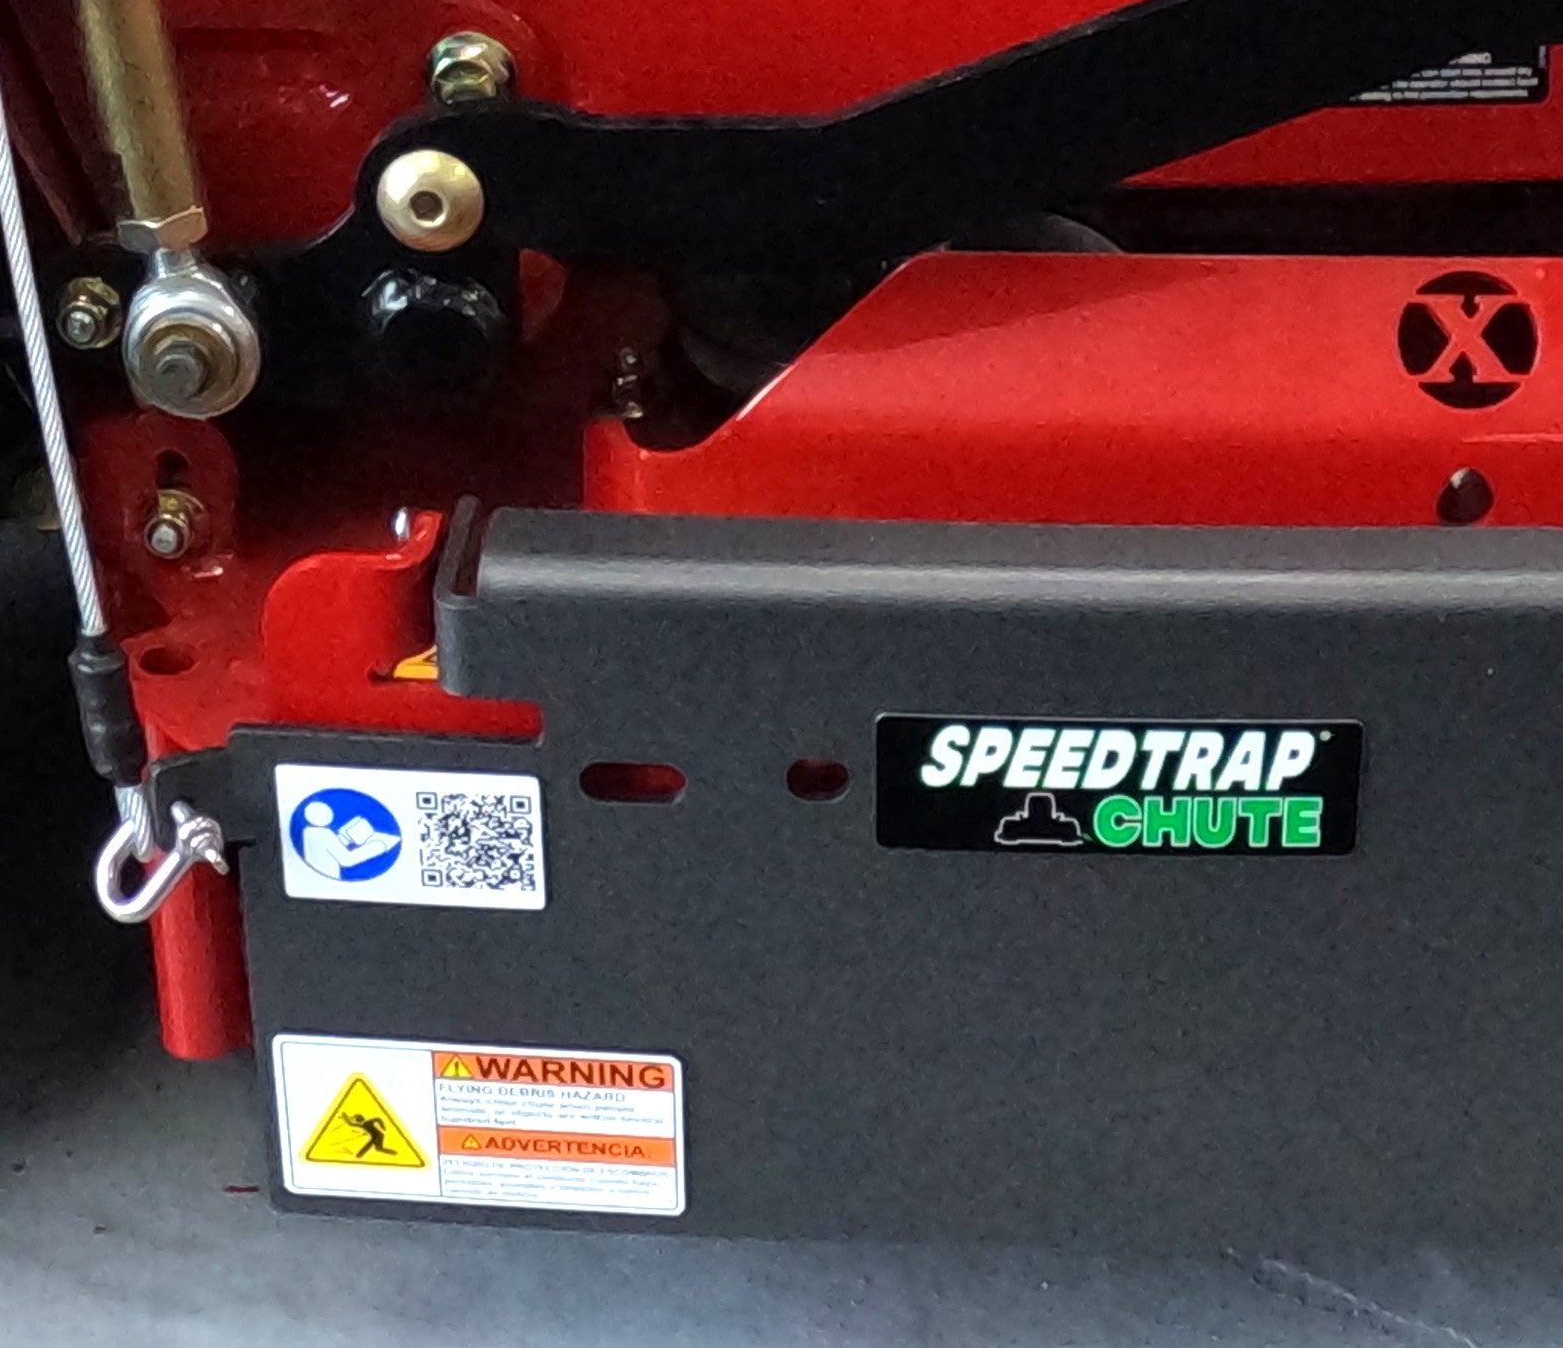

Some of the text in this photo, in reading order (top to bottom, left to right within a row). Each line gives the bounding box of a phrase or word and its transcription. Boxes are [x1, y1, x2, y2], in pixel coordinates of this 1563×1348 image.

[919, 723, 1317, 792] SPEEDTRAP
[1092, 794, 1324, 849] CHUTE
[475, 1055, 666, 1089] WARNING
[560, 1090, 627, 1103] HAZARD
[484, 1135, 646, 1160] ADVERTENCIA
